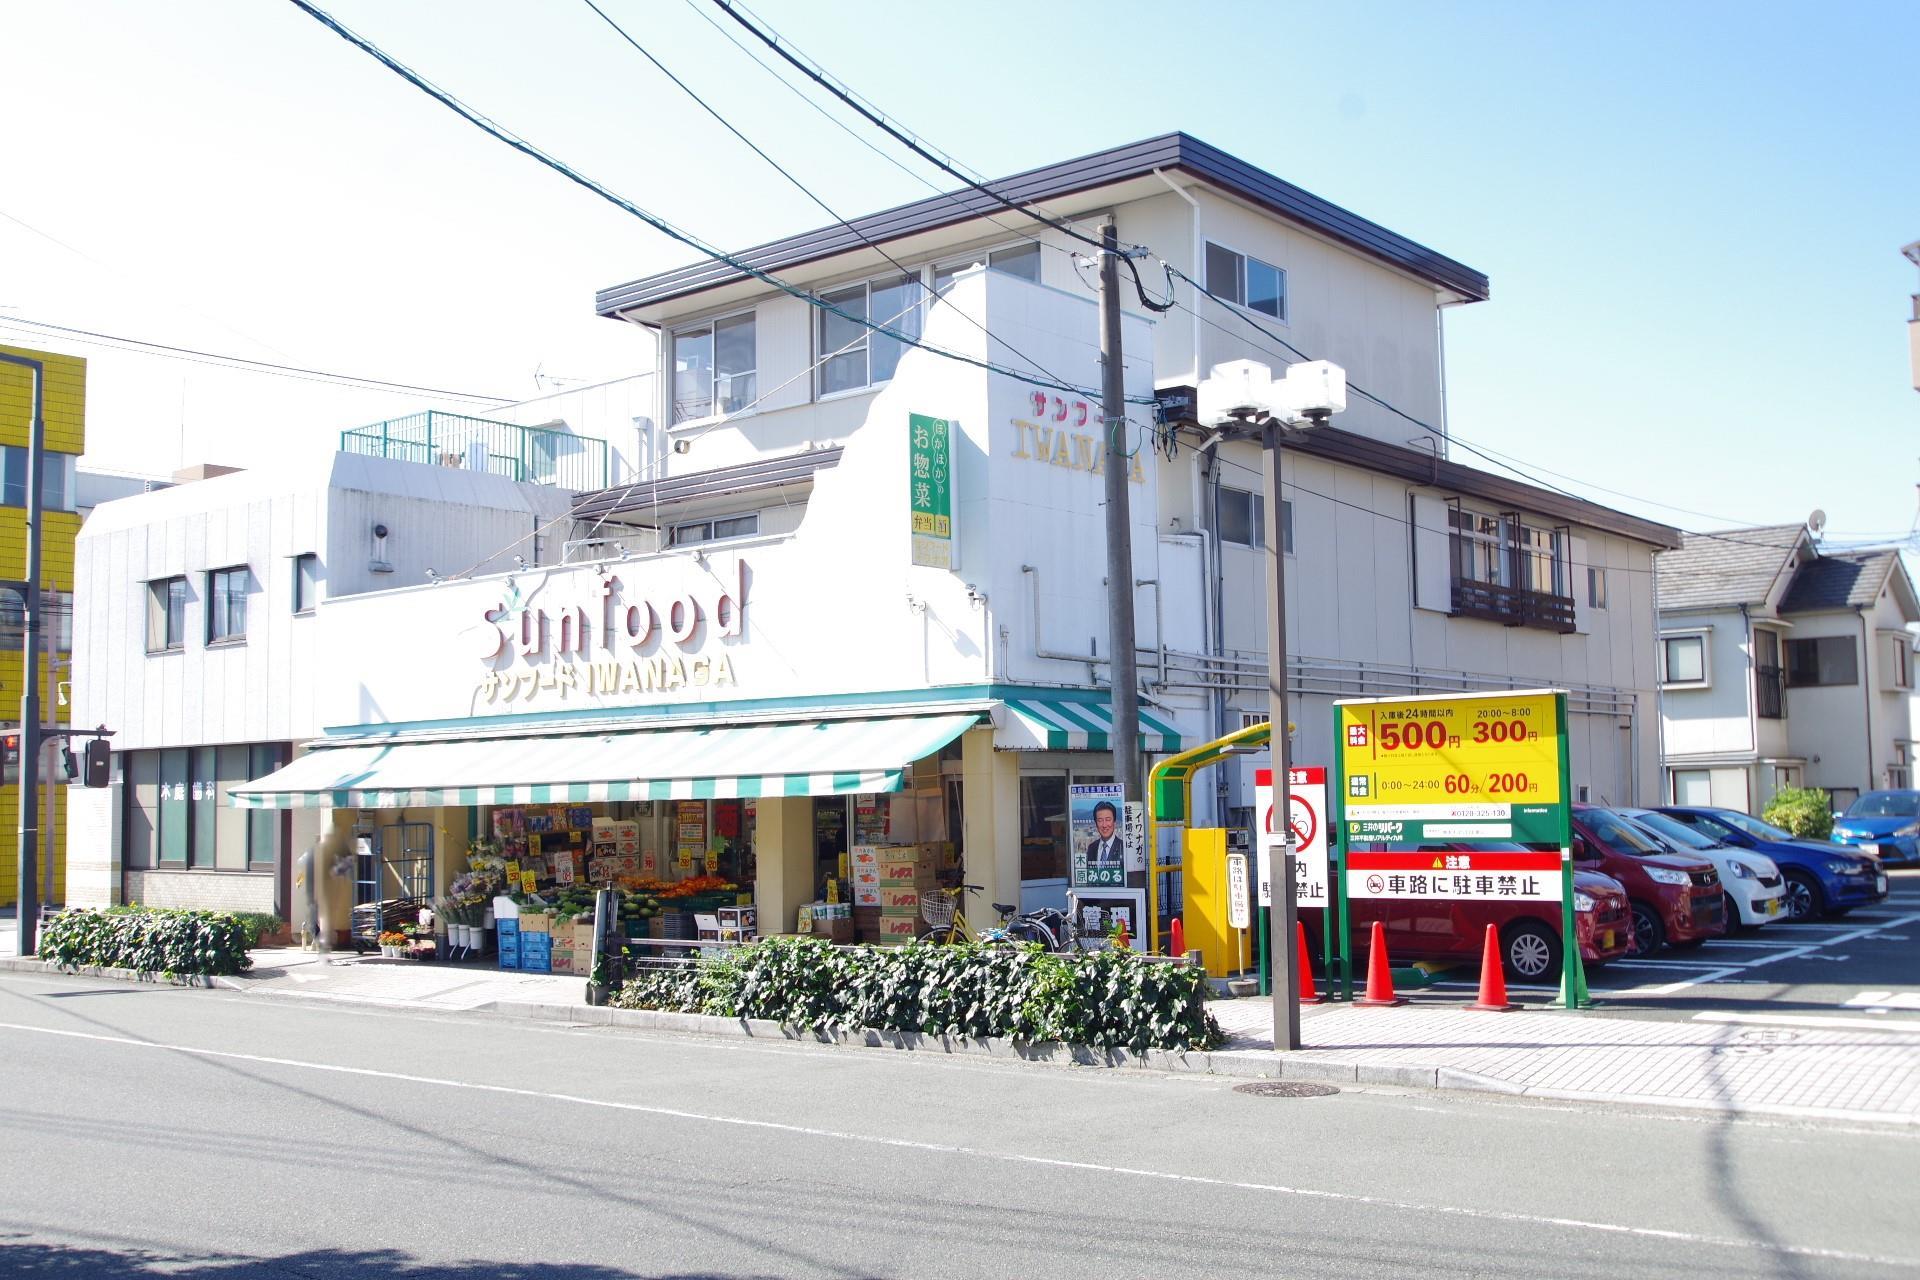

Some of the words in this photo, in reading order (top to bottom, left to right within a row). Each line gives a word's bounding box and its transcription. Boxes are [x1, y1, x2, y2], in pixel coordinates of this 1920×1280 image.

[913, 425, 932, 508] お惣菜
[933, 422, 945, 495] ほかほかの
[914, 514, 933, 530] 弁当
[480, 558, 750, 664] Sunfood
[481, 661, 579, 704] サンフード
[586, 653, 740, 695] IWANAGA
[1380, 709, 1454, 720] 入庫後24時間以内
[1135, 812, 1144, 863] イワナガの
[1362, 821, 1403, 833] 三井のリパーク
[1445, 855, 1470, 869] 注意
[1262, 881, 1325, 899] 駐禁止
[1387, 874, 1541, 896] 車路に駐車禁止
